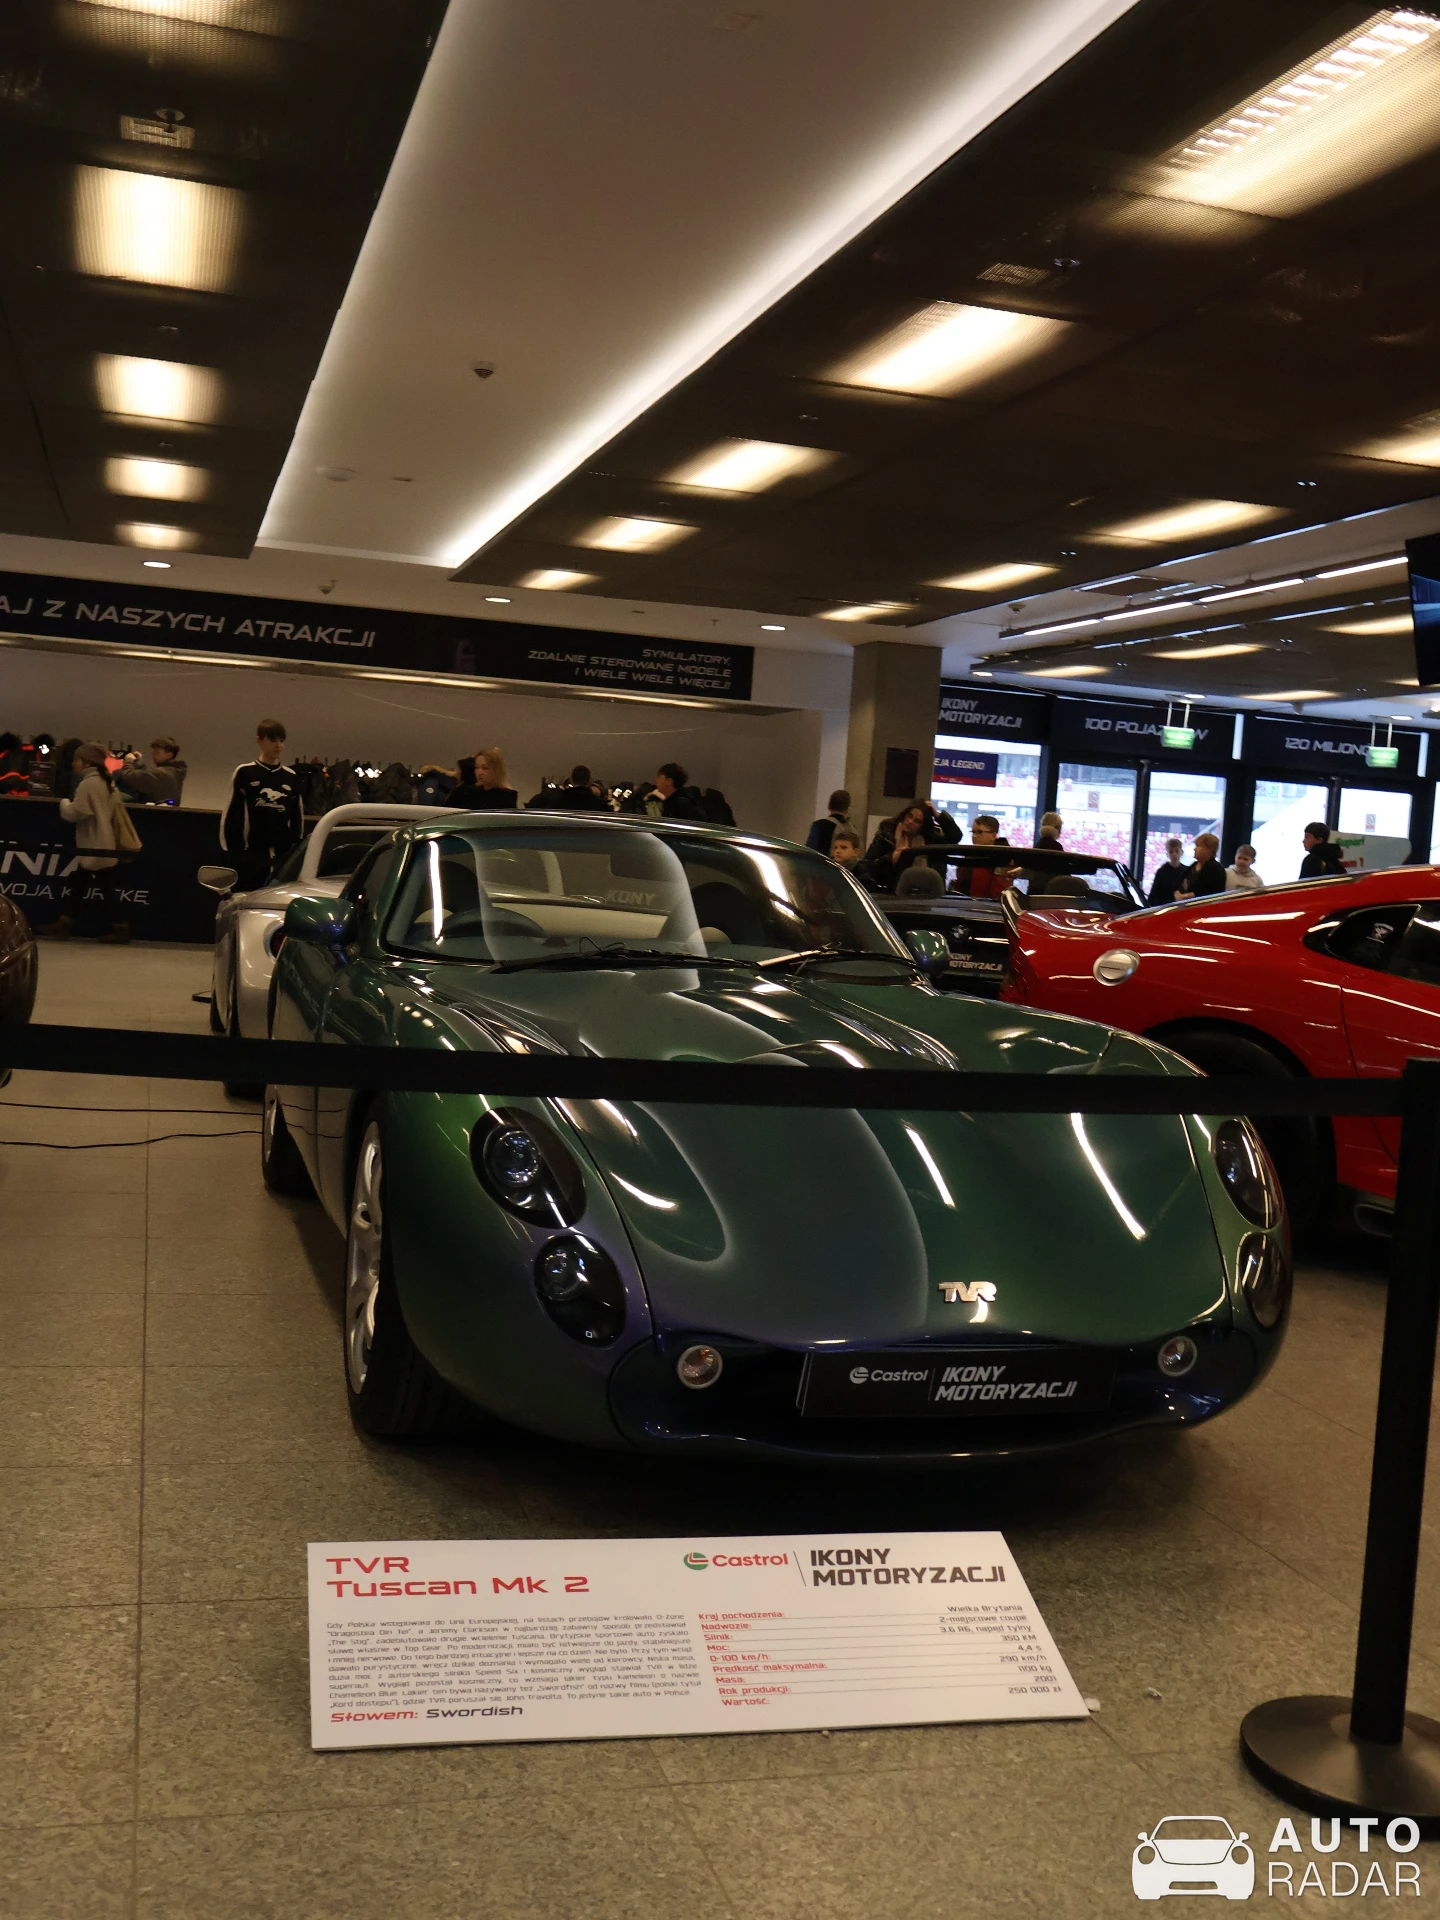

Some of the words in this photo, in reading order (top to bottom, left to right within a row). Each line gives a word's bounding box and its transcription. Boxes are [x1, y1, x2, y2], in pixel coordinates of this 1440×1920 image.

[42, 600, 66, 617] Z
[75, 603, 225, 633] NASZYCH
[234, 619, 376, 648] ATRAKCJI
[528, 650, 586, 664] ZDALNIE
[590, 656, 674, 672] STEROWANE
[678, 664, 732, 678] MODELE
[575, 667, 579, 676] I
[584, 668, 627, 680] WIELE
[632, 672, 674, 684] WIELE
[941, 697, 979, 711] IKONY
[939, 710, 1022, 728] MOTORYZACJI
[1085, 718, 1112, 731] 100
[1285, 737, 1311, 750] 120
[951, 759, 985, 770] LEGEND
[938, 1281, 997, 1302] TVR
[871, 1369, 928, 1382] Castrol
[942, 1365, 1006, 1383] IKONY
[934, 1381, 1077, 1401] MOTORYZACJI
[326, 1556, 410, 1574] TVR
[712, 1553, 788, 1567] Castrol
[811, 1548, 891, 1566] IKONY
[813, 1566, 1006, 1586] MOTORYZACJI
[326, 1580, 477, 1597] Tuscan
[492, 1576, 549, 1594] Mk
[564, 1576, 590, 1593] 2
[698, 1612, 718, 1621] Kraj
[721, 1611, 785, 1620] pochodzenia:
[947, 1605, 979, 1613] Wielka
[981, 1604, 1023, 1613] Brytania
[701, 1623, 752, 1631] Nadwozie:
[939, 1615, 997, 1624] 2-miejscowe
[704, 1633, 733, 1641] Silnik:
[1007, 1624, 1032, 1633] tylny
[404, 1645, 419, 1654] Top
[710, 1654, 738, 1662] 0-100
[741, 1653, 771, 1661] km/h:
[763, 1662, 827, 1672] maksymalna:
[1021, 1654, 1047, 1662] km/h
[715, 1676, 746, 1684] Masa:
[1040, 1665, 1052, 1673] kg
[718, 1687, 738, 1695] Rok
[741, 1685, 791, 1695] produkcji:
[1008, 1686, 1028, 1694] 250
[330, 1711, 418, 1723] Słowem:
[426, 1706, 523, 1720] Swordish
